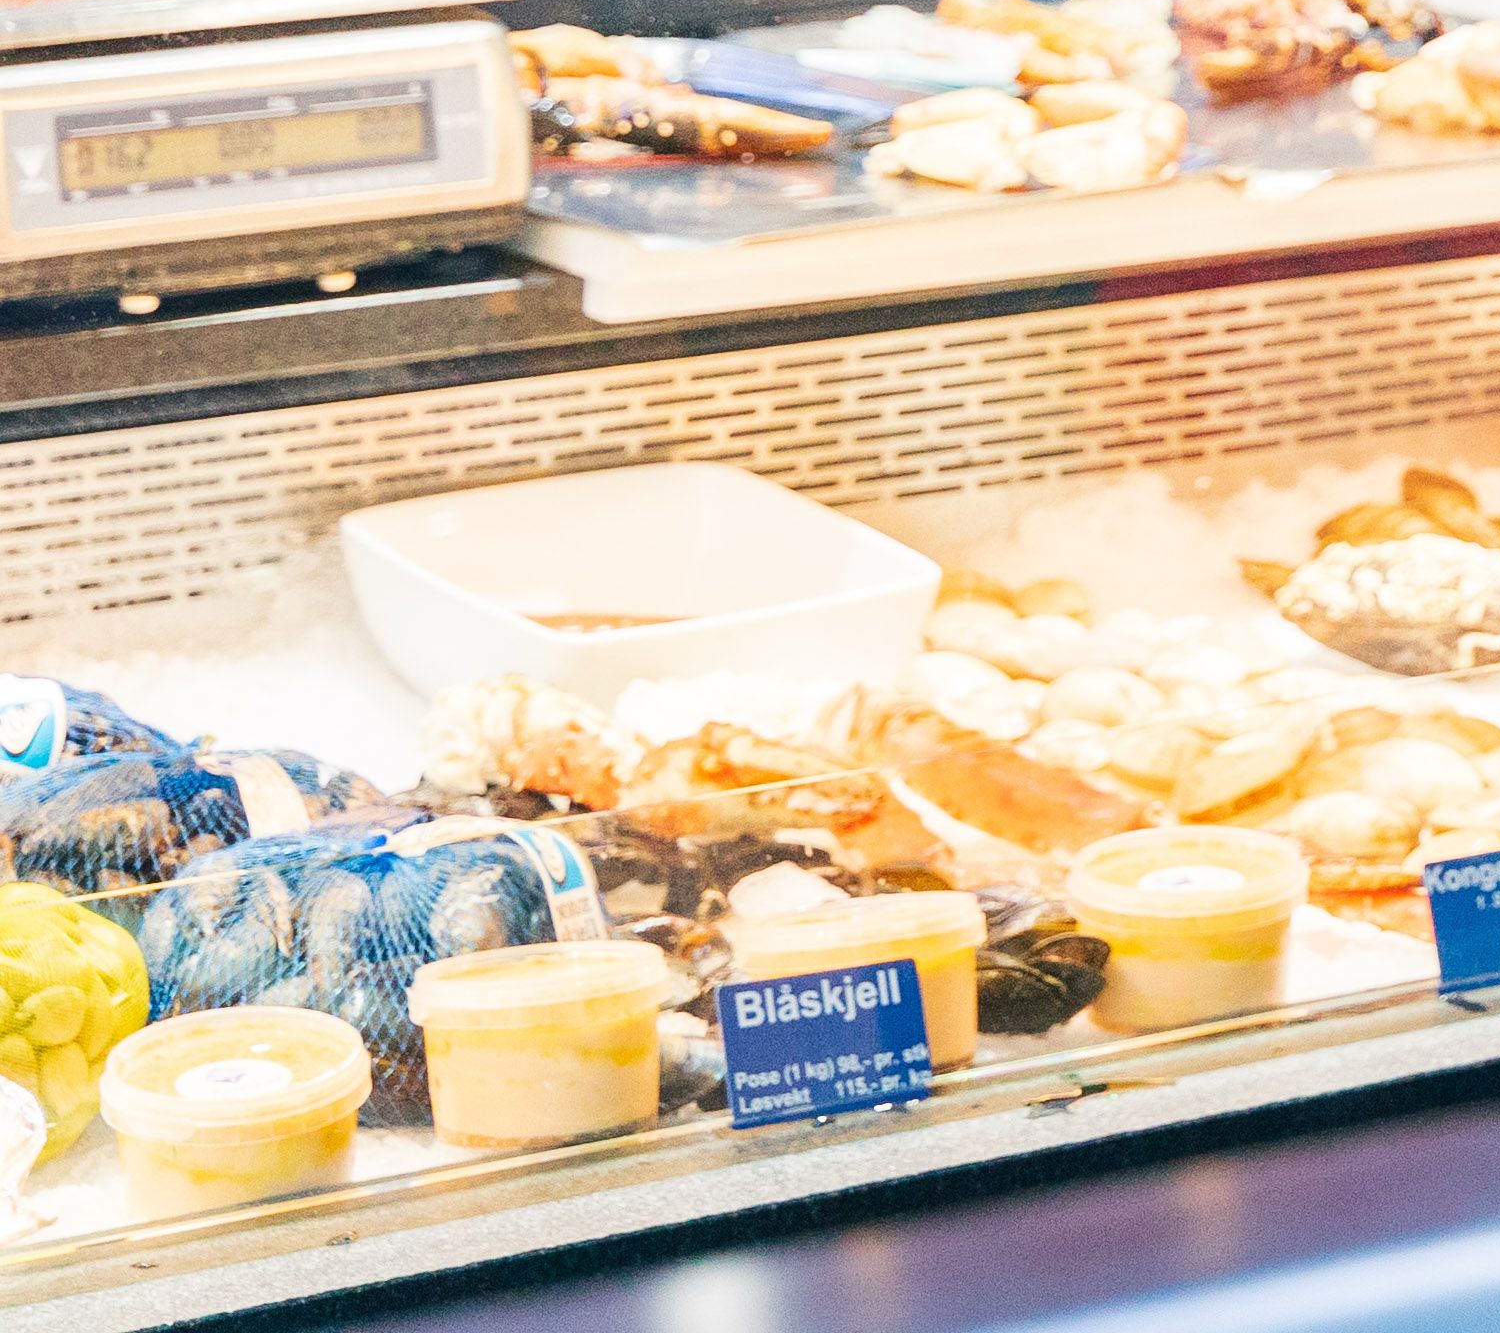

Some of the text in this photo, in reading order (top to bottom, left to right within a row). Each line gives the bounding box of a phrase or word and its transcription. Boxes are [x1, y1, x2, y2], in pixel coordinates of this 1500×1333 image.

[735, 968, 901, 1028] Blåskjell
[734, 1070, 781, 1090] Pose
[784, 1063, 801, 1084] (1
[805, 1058, 835, 1082] kg)
[873, 1052, 900, 1071] pr.
[738, 1087, 812, 1114] Løsvekt
[835, 1076, 878, 1098] 115,-
[880, 1073, 907, 1092] pr.
